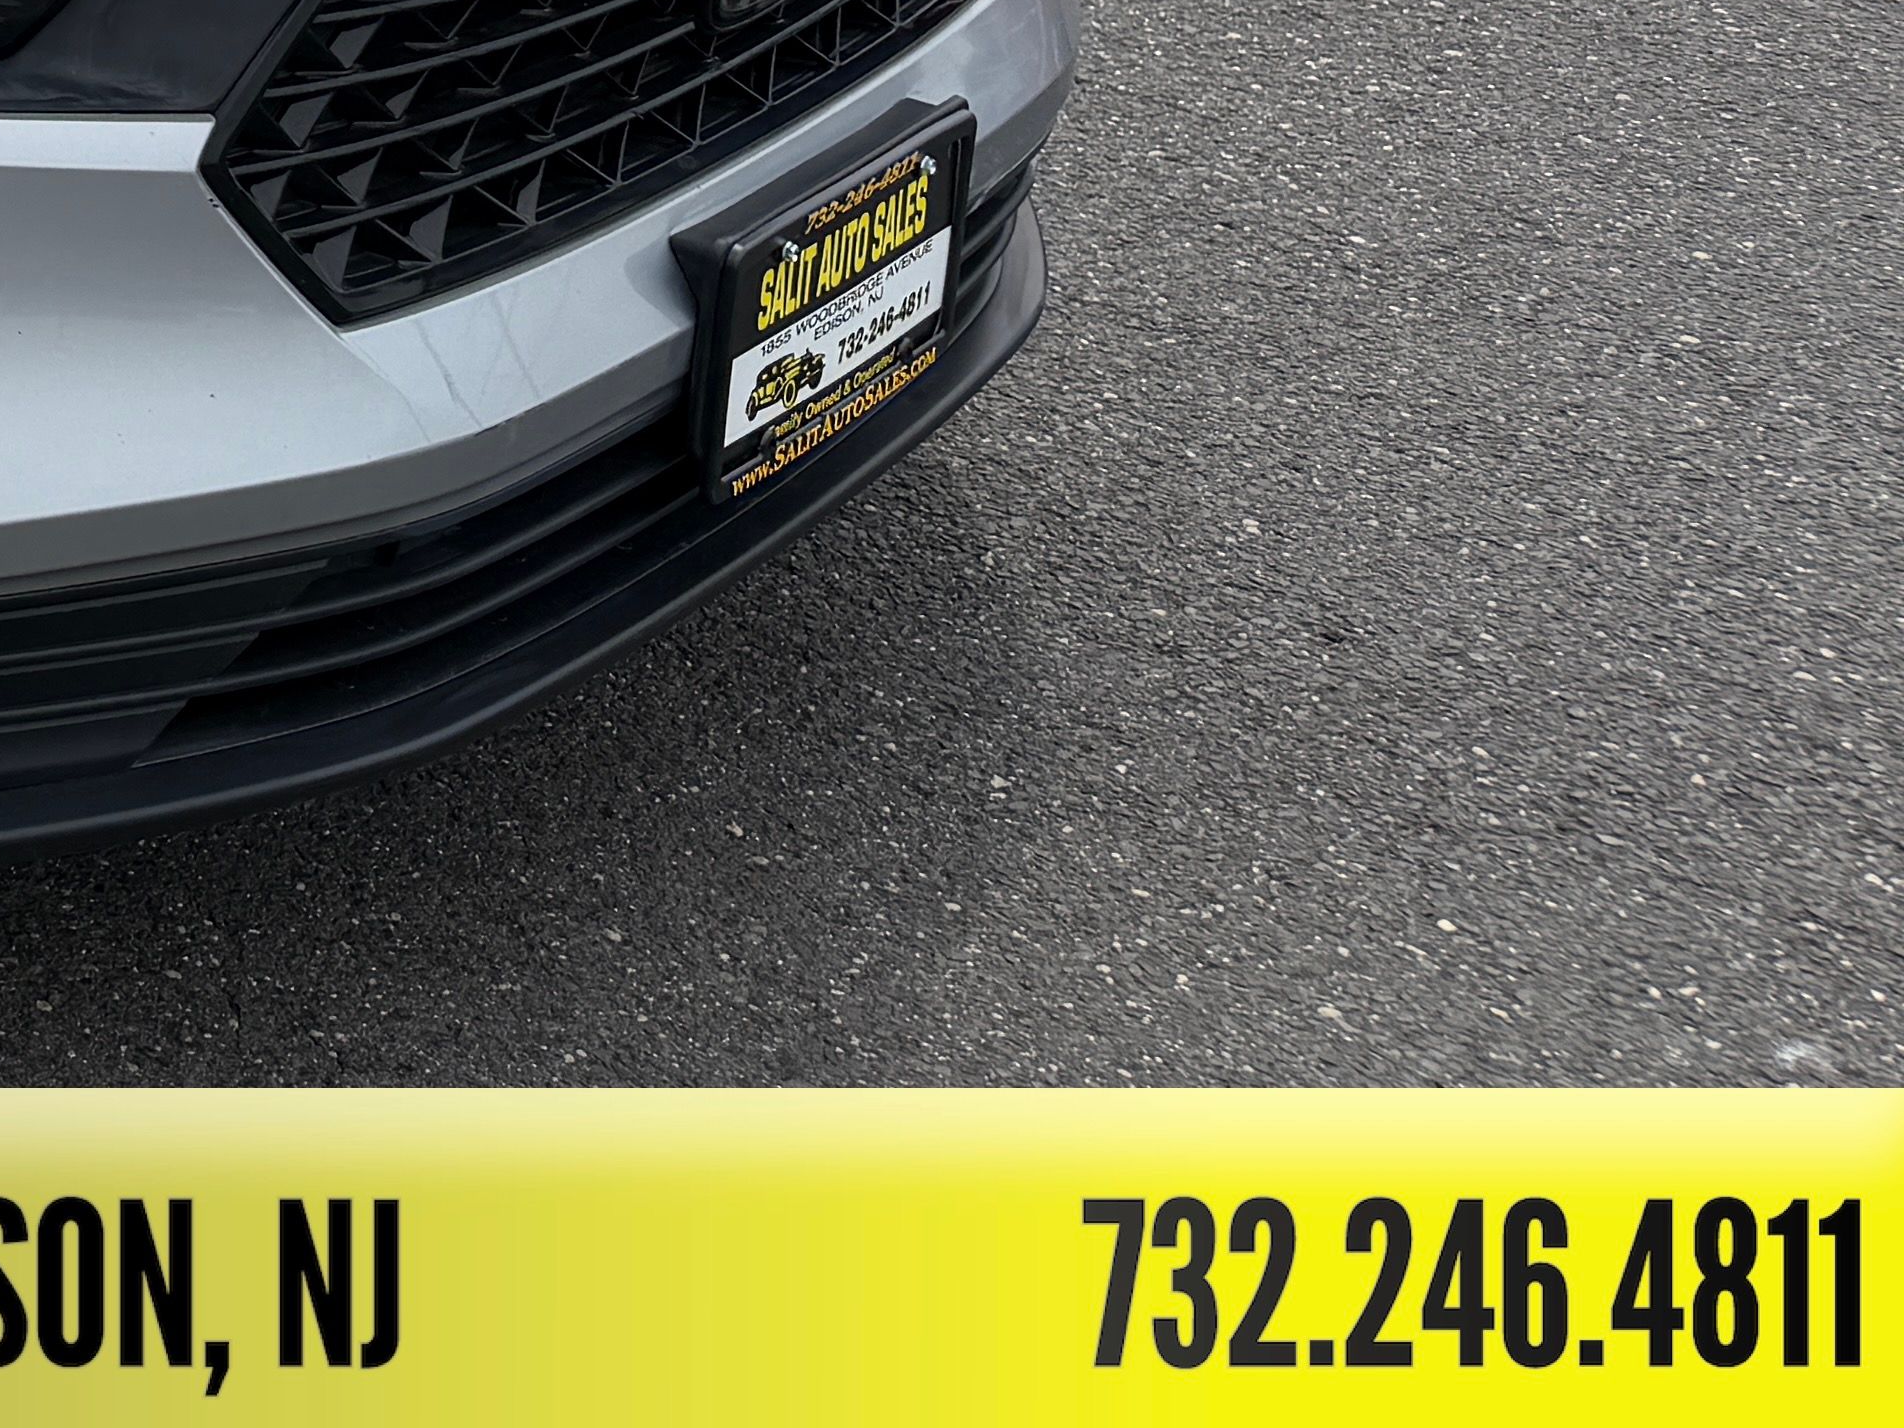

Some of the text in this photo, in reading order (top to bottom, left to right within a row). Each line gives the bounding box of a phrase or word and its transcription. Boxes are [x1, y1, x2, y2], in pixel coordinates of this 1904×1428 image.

[804, 150, 923, 235] 732-246-4811
[758, 175, 929, 331] SALIT AUTO SALES
[760, 239, 934, 357] 1855 WOODBRIDGE AVENUE
[837, 280, 931, 364] 732-246-4811
[868, 286, 885, 307] NJ
[806, 385, 842, 420] Owned
